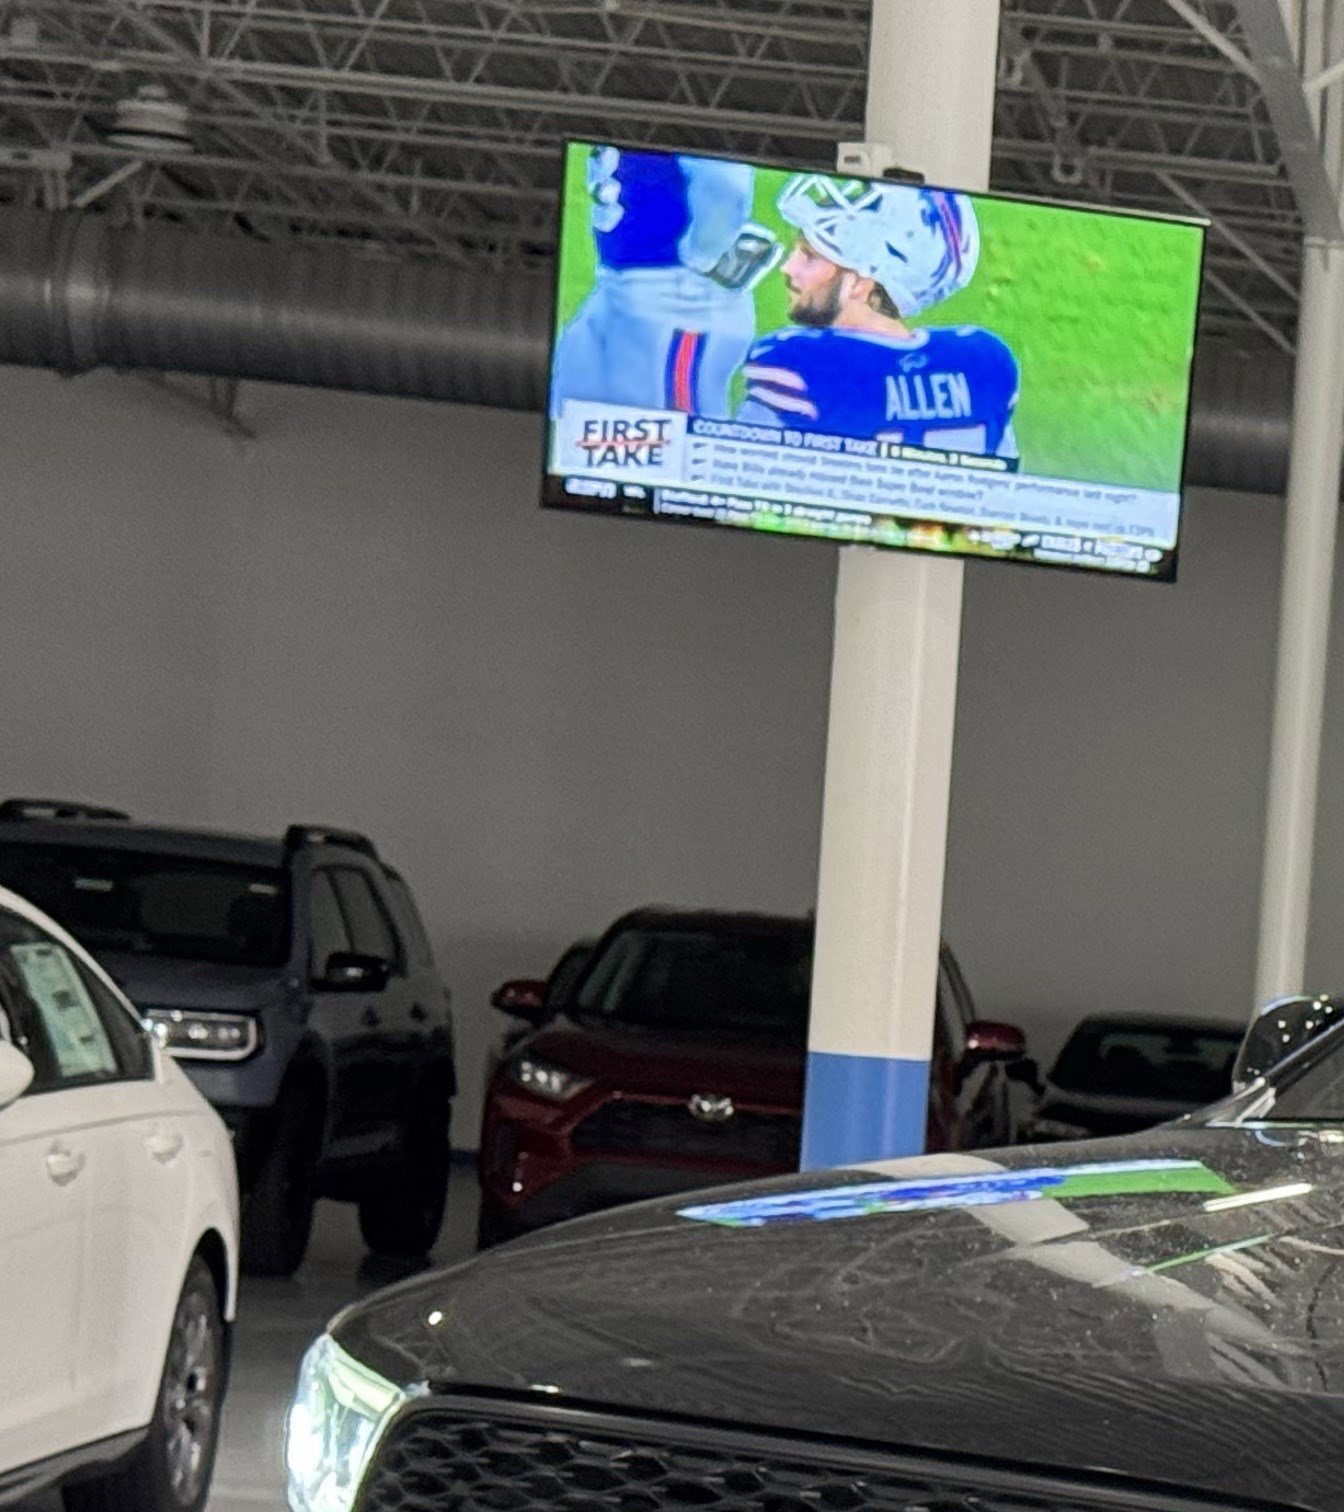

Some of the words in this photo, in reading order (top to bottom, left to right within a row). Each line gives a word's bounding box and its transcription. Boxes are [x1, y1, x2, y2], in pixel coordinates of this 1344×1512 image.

[885, 372, 972, 421] ALLEN
[583, 418, 673, 442] FIRST
[583, 443, 665, 468] TAKE
